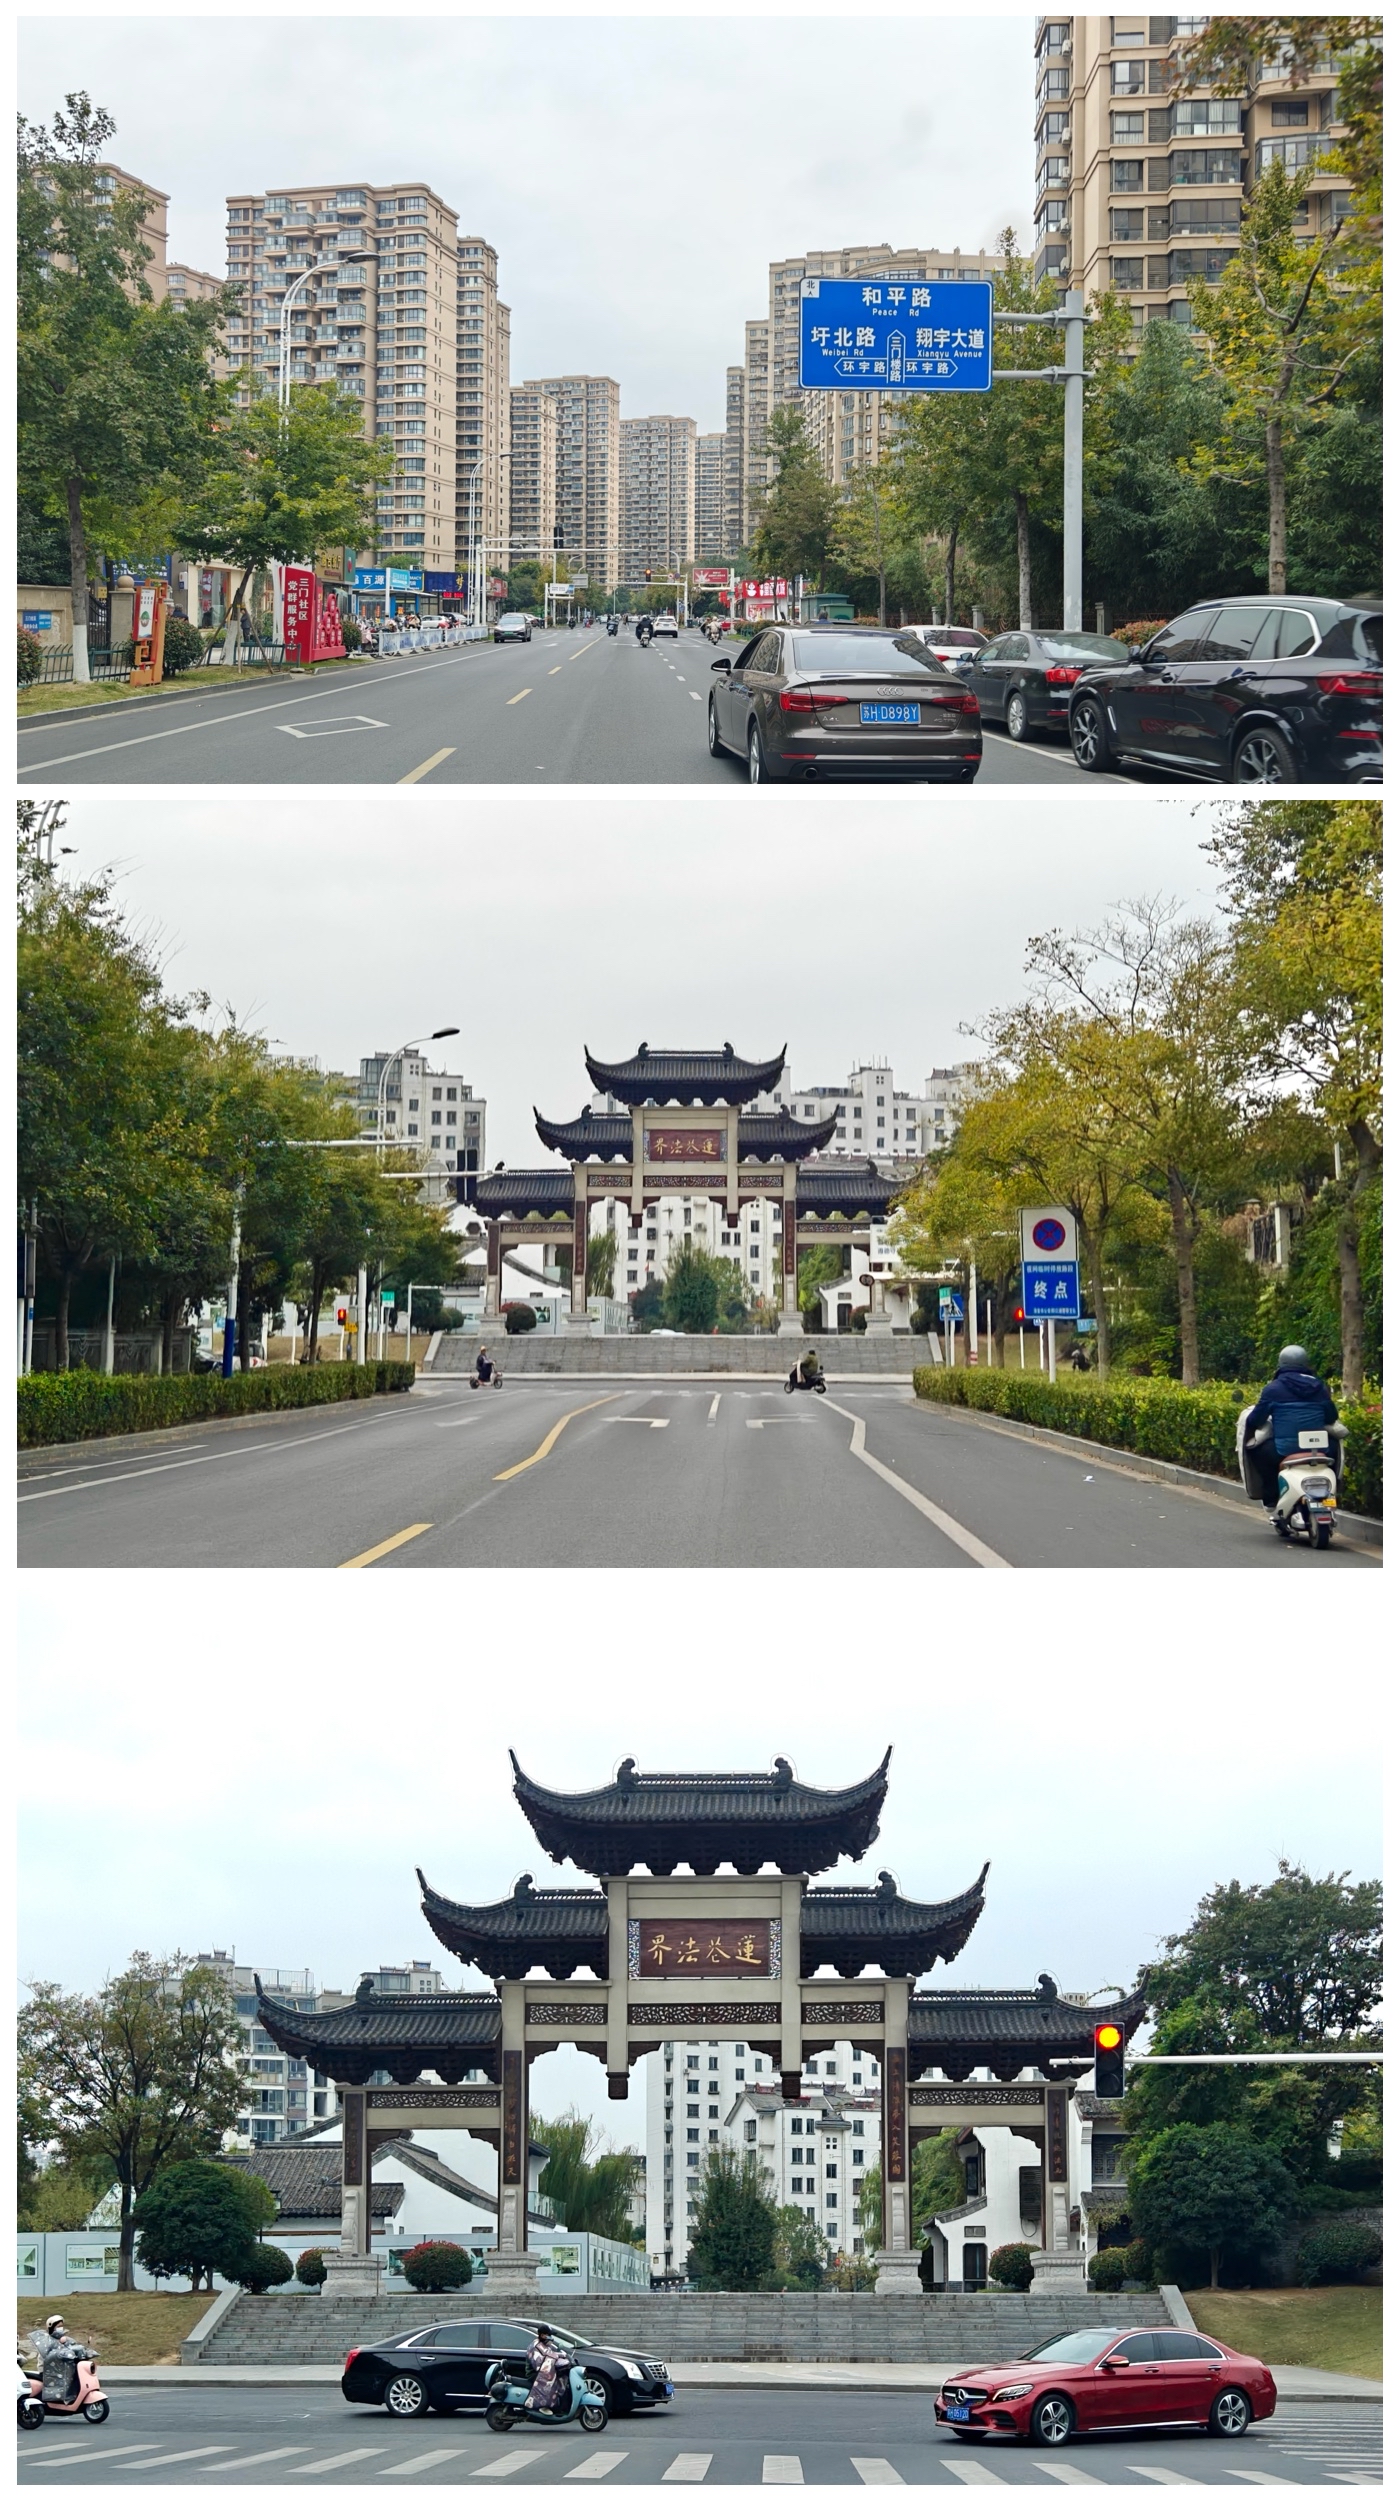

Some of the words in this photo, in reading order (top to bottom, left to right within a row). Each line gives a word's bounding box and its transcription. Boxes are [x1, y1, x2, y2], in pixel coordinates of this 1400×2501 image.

[806, 280, 815, 288] 北
[862, 286, 931, 307] 和平路
[872, 308, 898, 316] Peace
[909, 309, 920, 317] Rd
[811, 326, 876, 347] 圩北路
[916, 328, 985, 349] 翔宇大道
[889, 336, 902, 382] 三门楼路
[917, 350, 949, 359] Xiangyu
[843, 361, 886, 373] 环宇路
[906, 361, 949, 374] 环宇路
[298, 578, 310, 621] 三门社区
[287, 580, 298, 650] 党群服务中心
[1034, 1280, 1068, 1299] 终点
